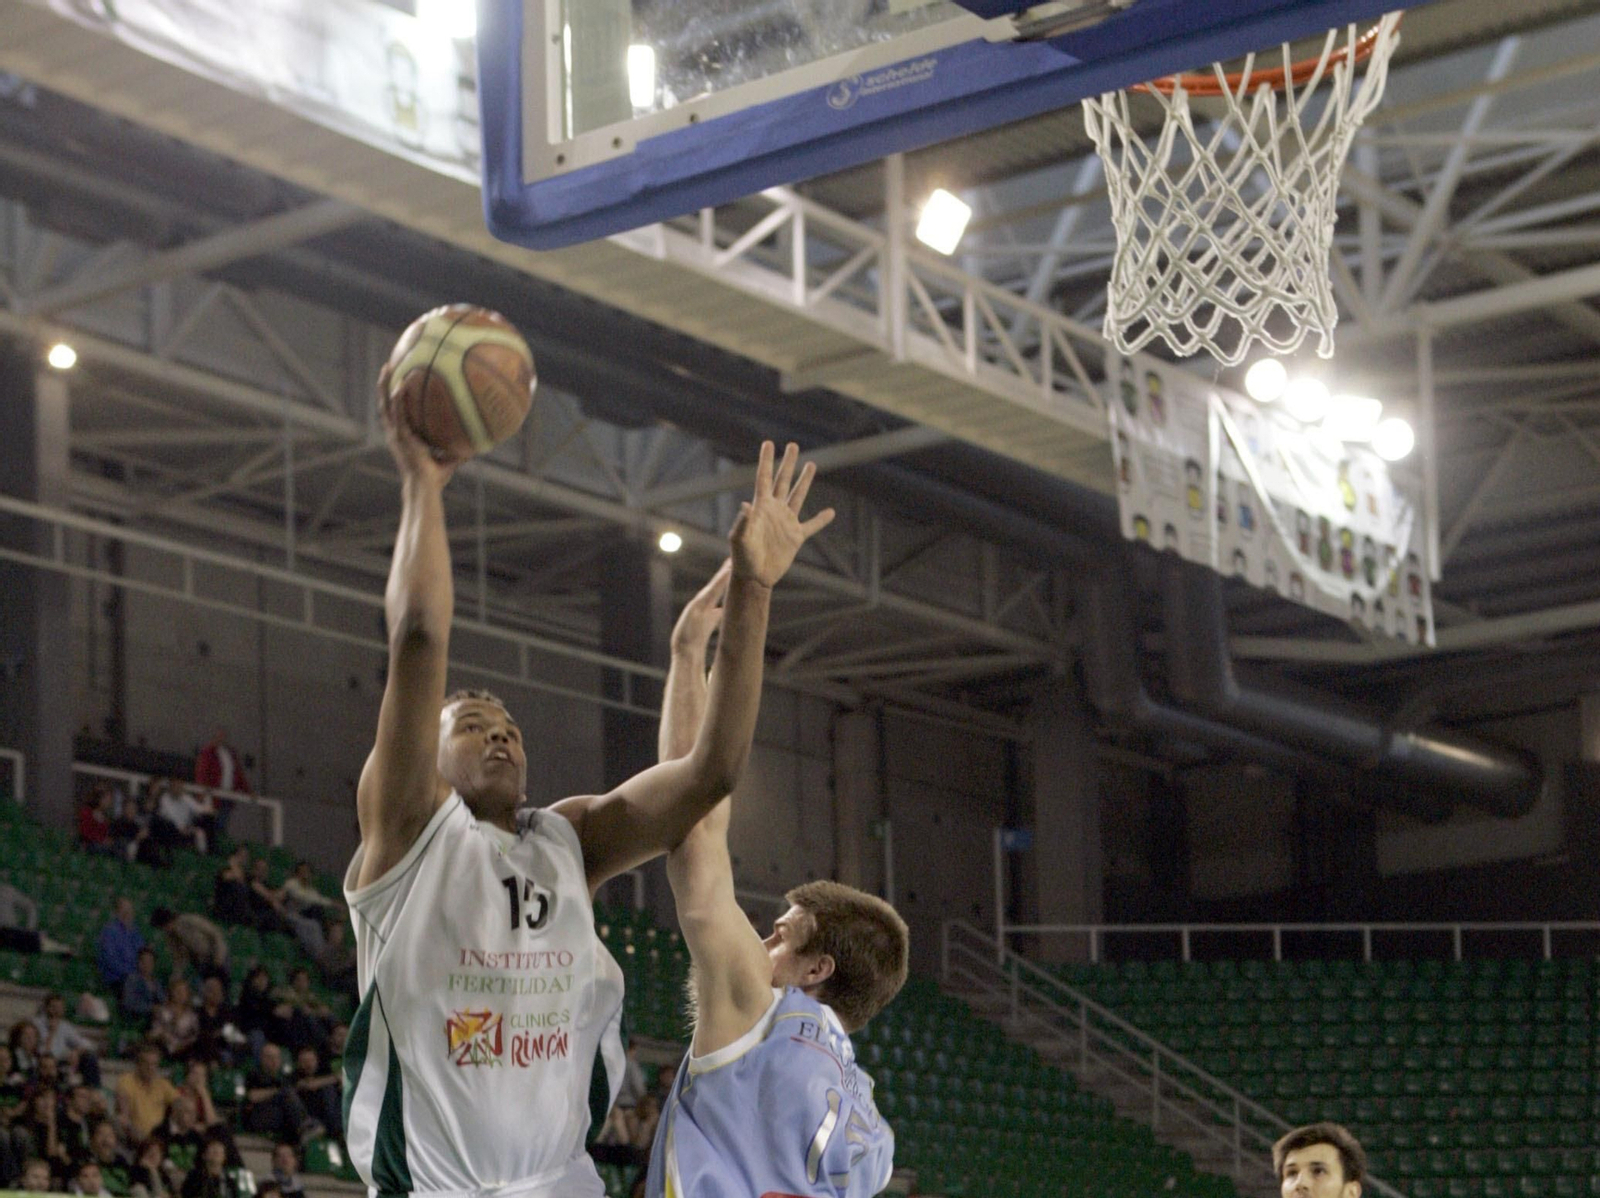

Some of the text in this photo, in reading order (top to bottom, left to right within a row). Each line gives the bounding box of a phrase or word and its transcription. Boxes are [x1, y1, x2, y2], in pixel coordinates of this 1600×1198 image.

[502, 875, 548, 931] 15
[459, 948, 574, 970] INSTITUTO
[510, 1009, 570, 1029] CLINICS
